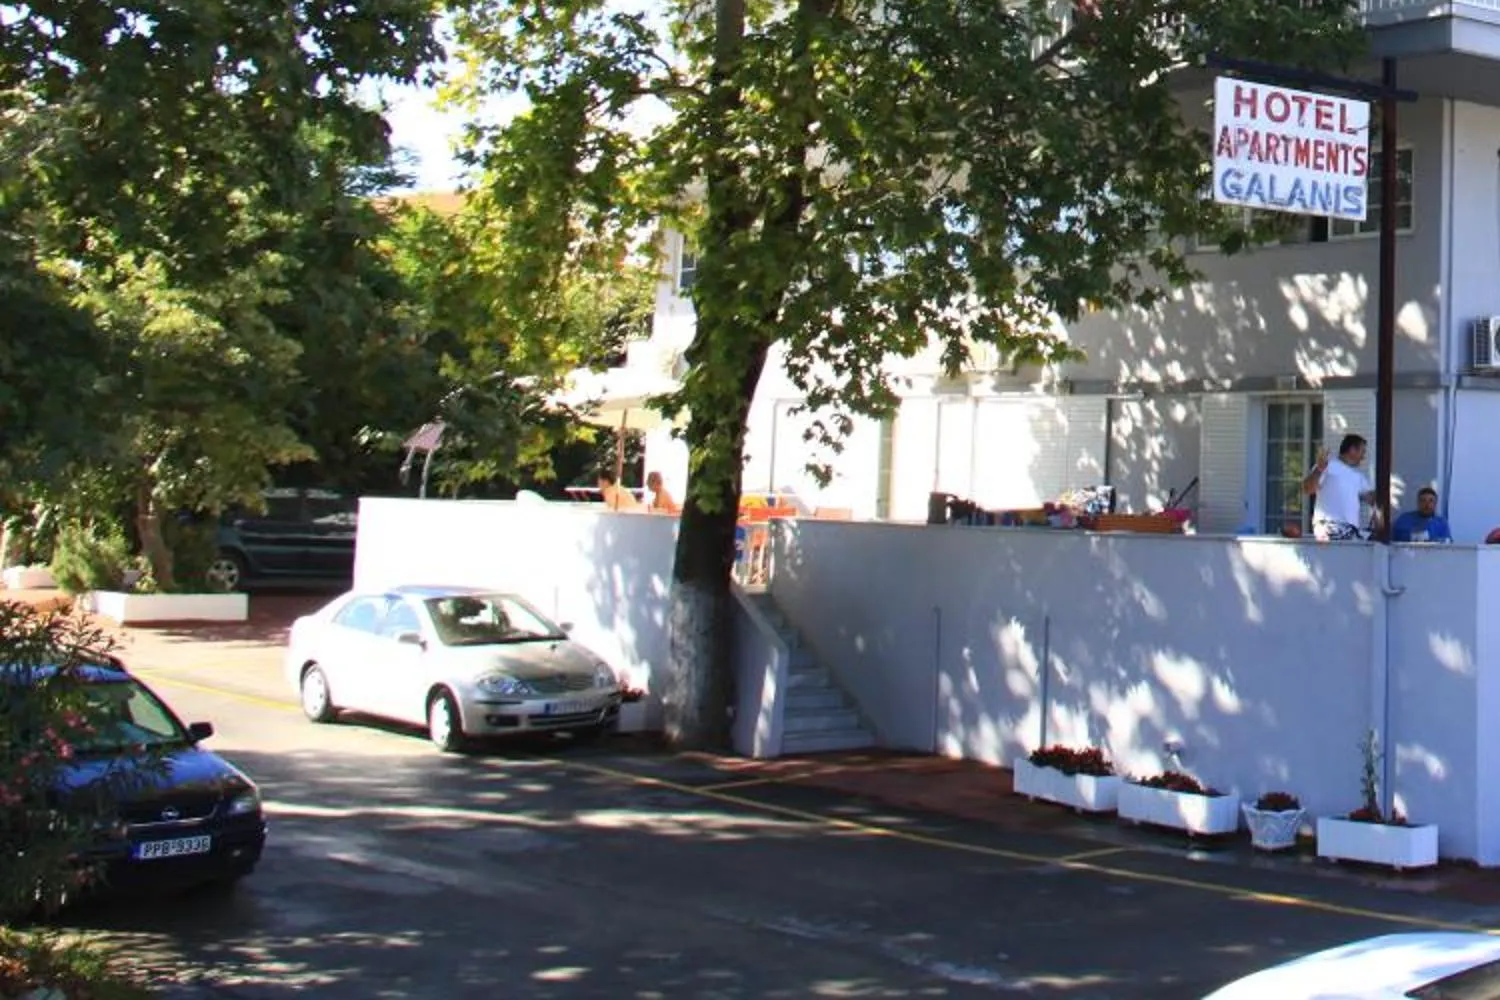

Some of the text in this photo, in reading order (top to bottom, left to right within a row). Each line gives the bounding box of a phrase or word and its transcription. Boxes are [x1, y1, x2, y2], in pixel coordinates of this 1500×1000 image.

[1233, 85, 1358, 135] HOTEL
[1217, 125, 1367, 177] APARTMENTS
[1220, 168, 1364, 216] GALANIS
